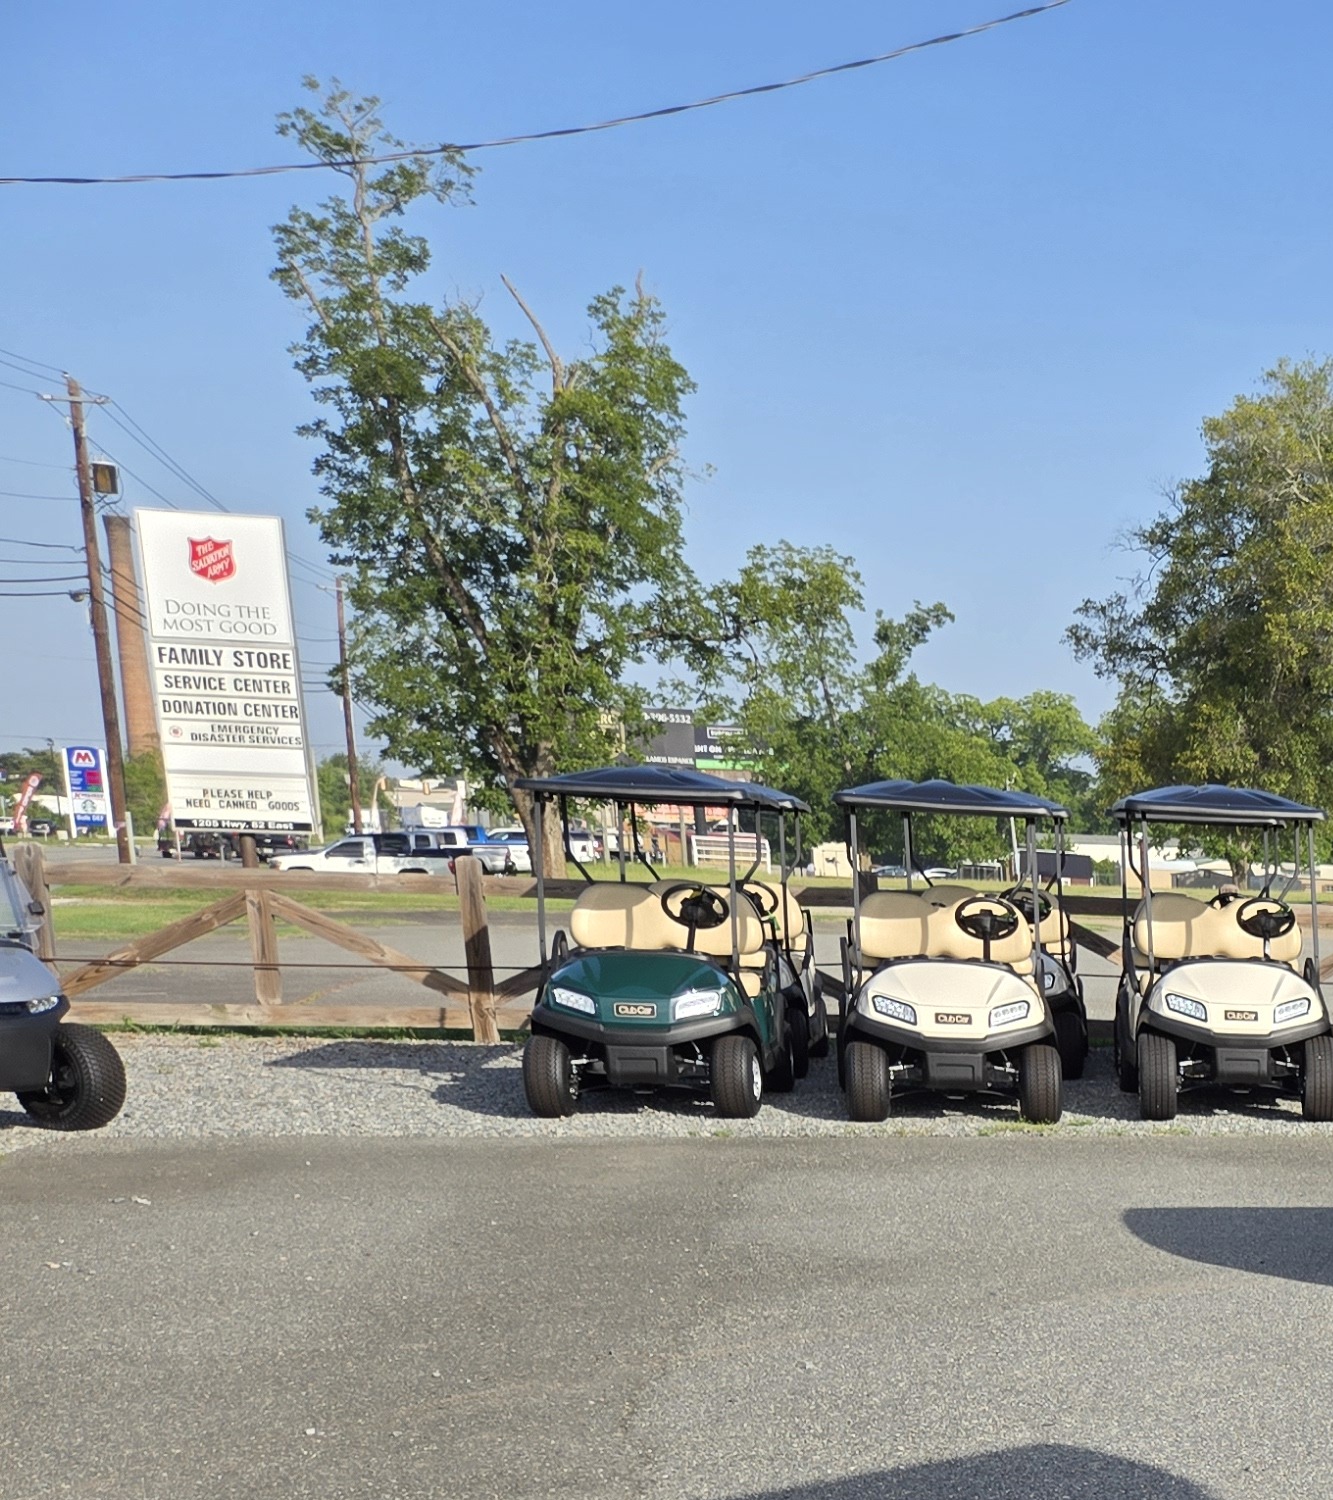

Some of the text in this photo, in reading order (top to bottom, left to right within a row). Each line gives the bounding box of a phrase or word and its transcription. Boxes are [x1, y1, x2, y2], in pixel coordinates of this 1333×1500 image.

[192, 544, 230, 571] SALVATION
[195, 541, 214, 556] THE
[207, 557, 230, 578] ARMY
[165, 599, 271, 620] DOING THE
[163, 618, 277, 636] MOST GOOD
[157, 647, 292, 669] FAMILY STORE
[164, 675, 291, 694] SERVICE CENTER
[162, 700, 299, 719] DONATION CENTER
[210, 724, 280, 735] EMERGENCY
[190, 733, 302, 745] DISASTER SERVICES
[202, 789, 273, 800] PLEASE HELP
[185, 799, 300, 811] NEED CANNED GOODS
[221, 820, 249, 830] Hwy.
[268, 821, 294, 831] East
